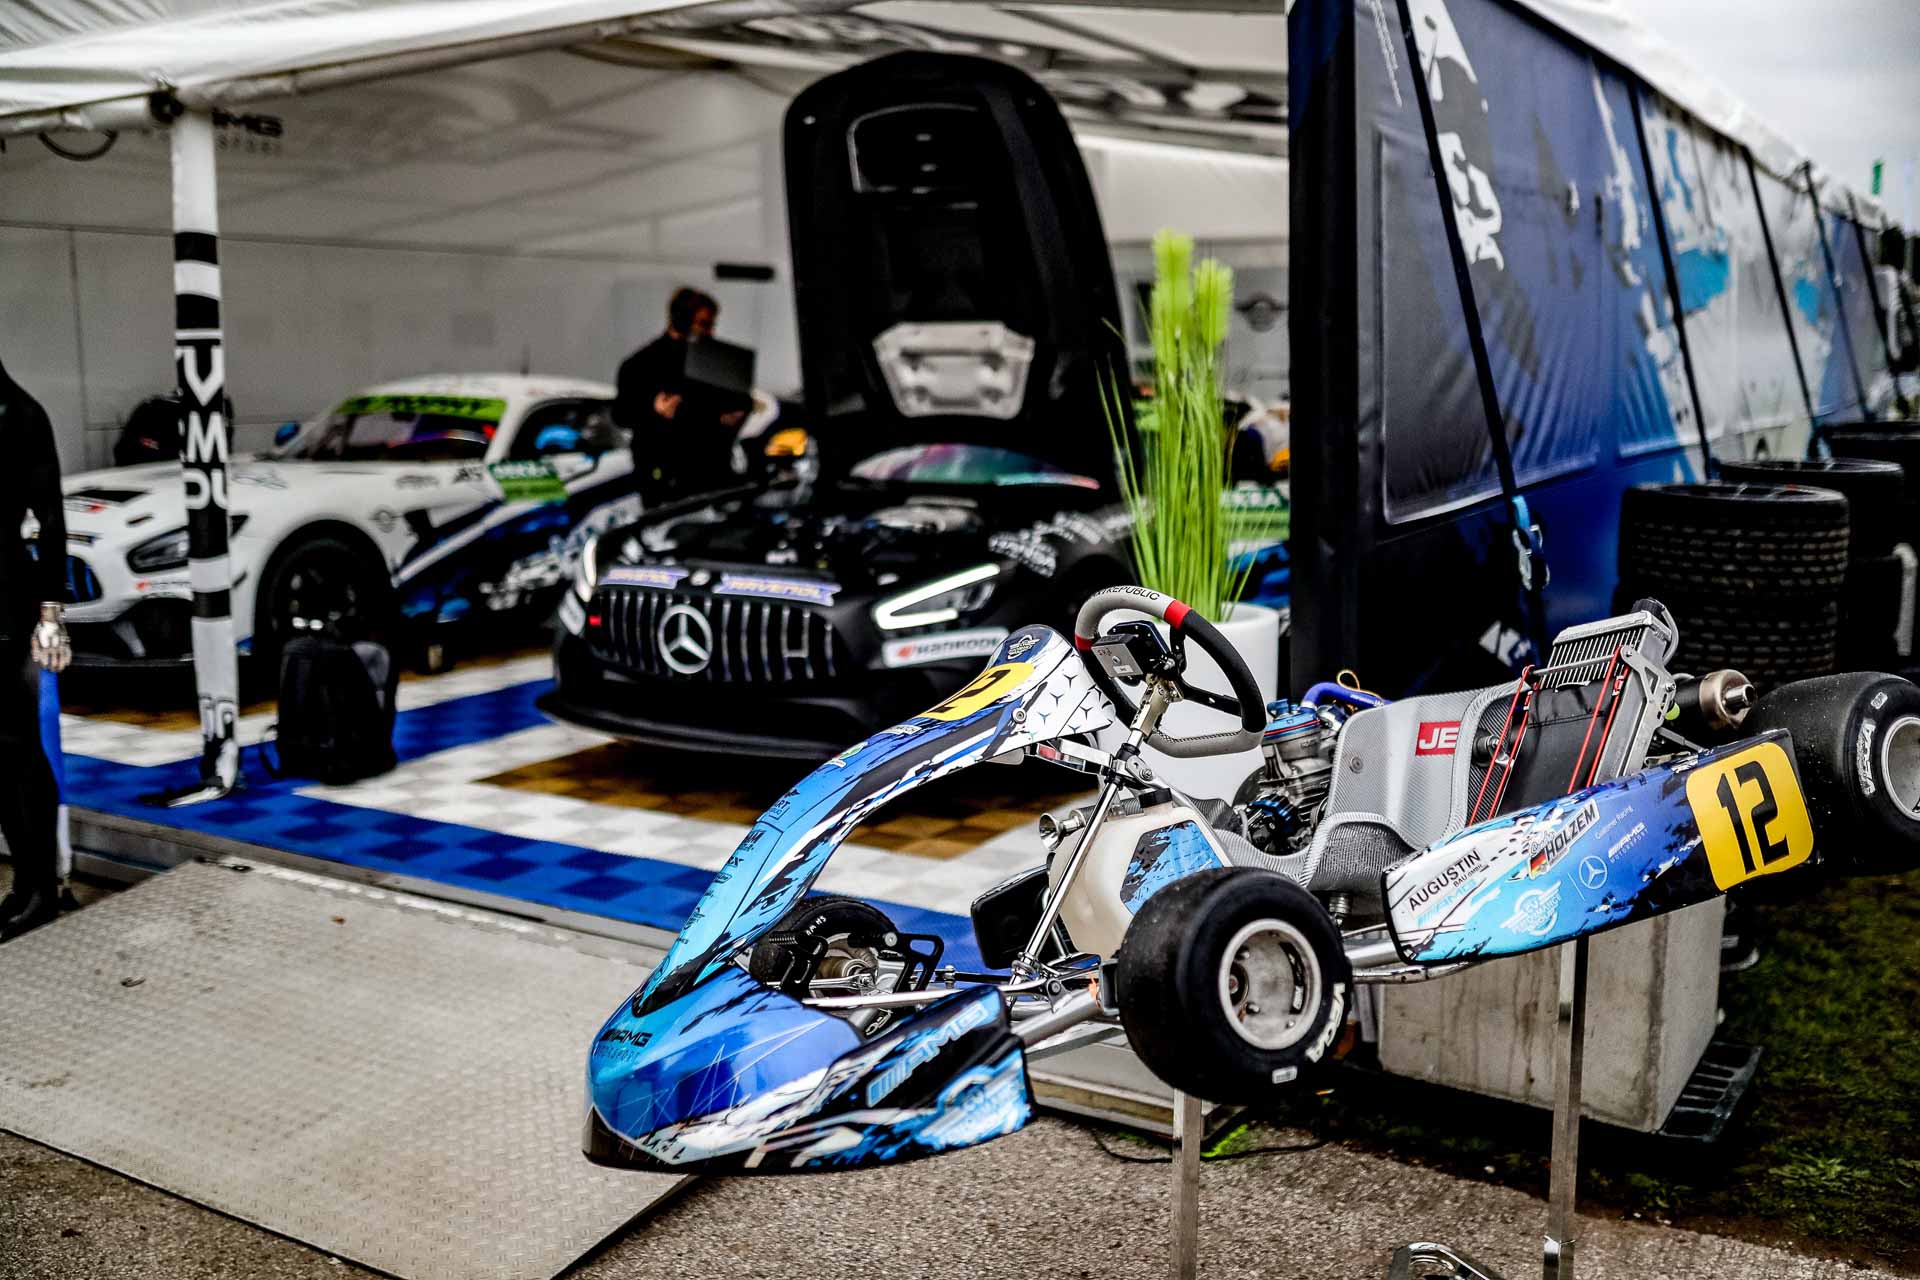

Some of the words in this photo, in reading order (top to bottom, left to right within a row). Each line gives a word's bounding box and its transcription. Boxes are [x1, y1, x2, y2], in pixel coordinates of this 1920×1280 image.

[1097, 585, 1160, 600] REPUBLIC
[1545, 804, 1596, 861] HOLZEM
[1717, 761, 1789, 874] 12
[1409, 849, 1481, 911] AUGUSTIN
[1453, 874, 1467, 888] BAU
[612, 1029, 653, 1048] AMG
[892, 1001, 989, 1083] AMG
[1305, 983, 1346, 1063] VEGA
